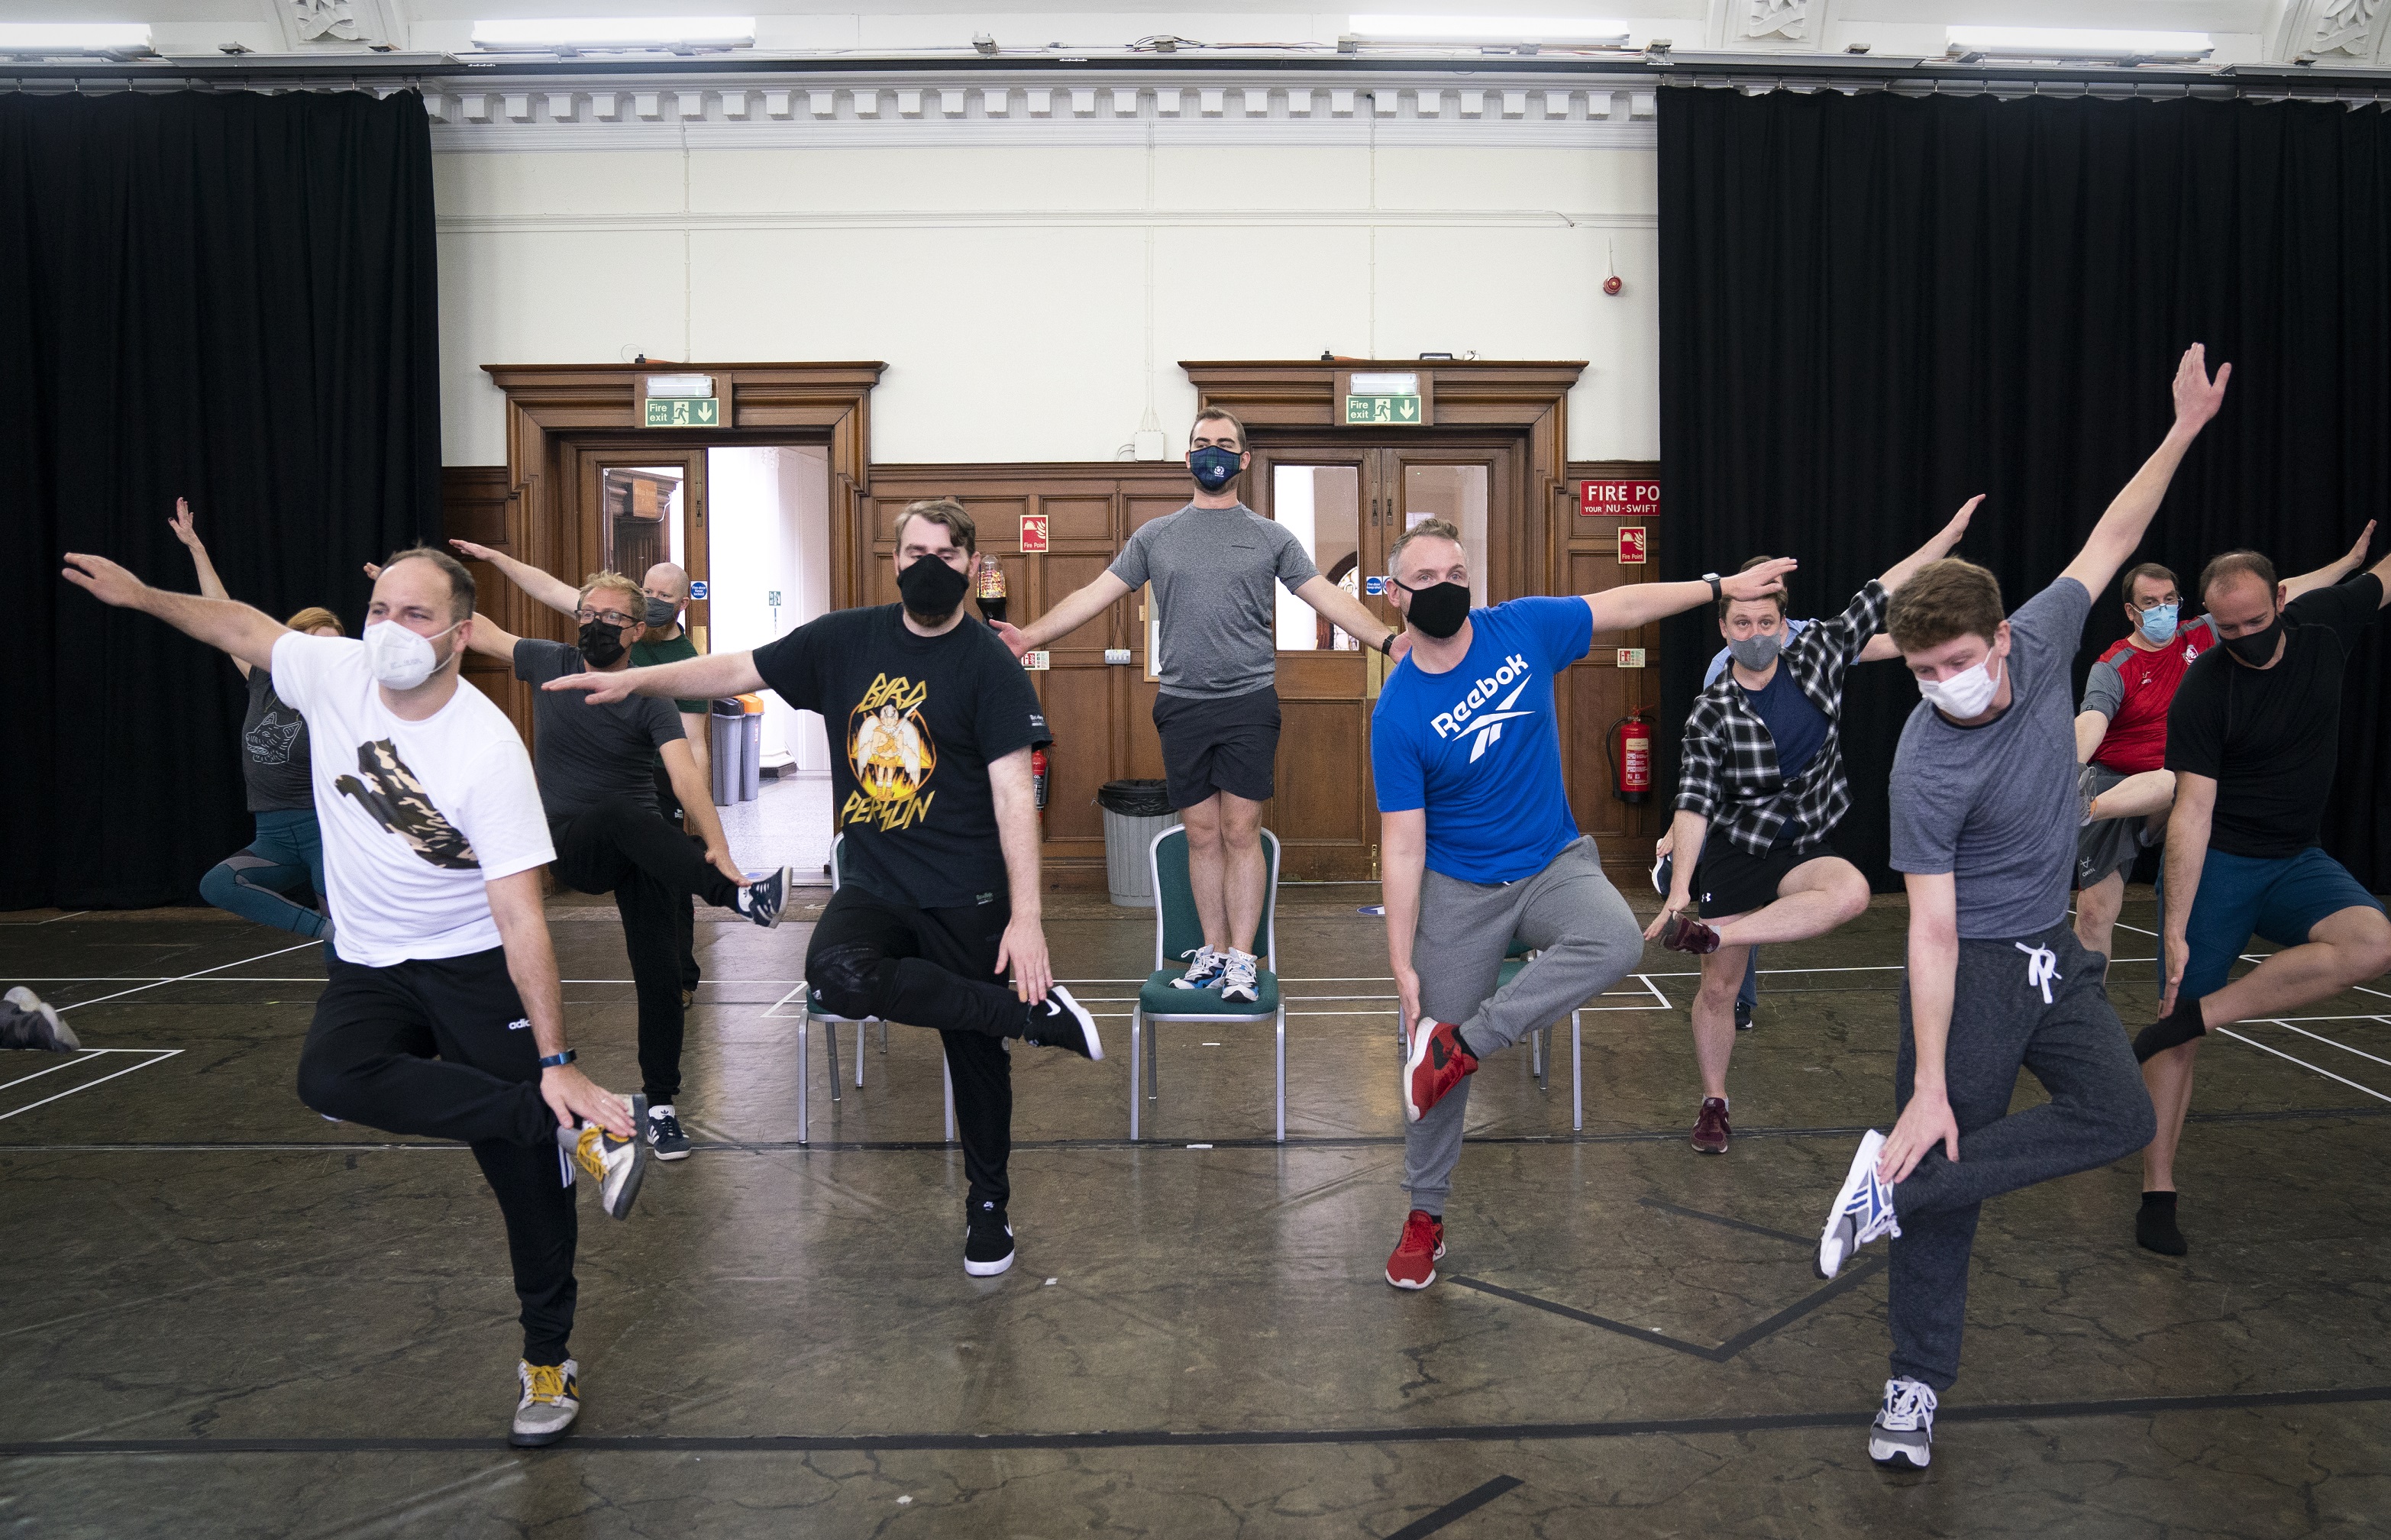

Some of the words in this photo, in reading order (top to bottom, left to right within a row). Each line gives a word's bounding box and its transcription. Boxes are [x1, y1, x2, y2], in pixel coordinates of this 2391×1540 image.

[649, 403, 667, 412] Fire
[1350, 400, 1368, 409] Fire
[649, 413, 667, 421] exit
[1350, 410, 1368, 418] exit
[1588, 486, 1627, 501] FIRE
[1636, 486, 1659, 501] PO
[1606, 504, 1657, 512] NU-SWIFT
[857, 673, 927, 713] BIRD
[1430, 654, 1529, 739] Reebok
[840, 789, 935, 832] PERSON
